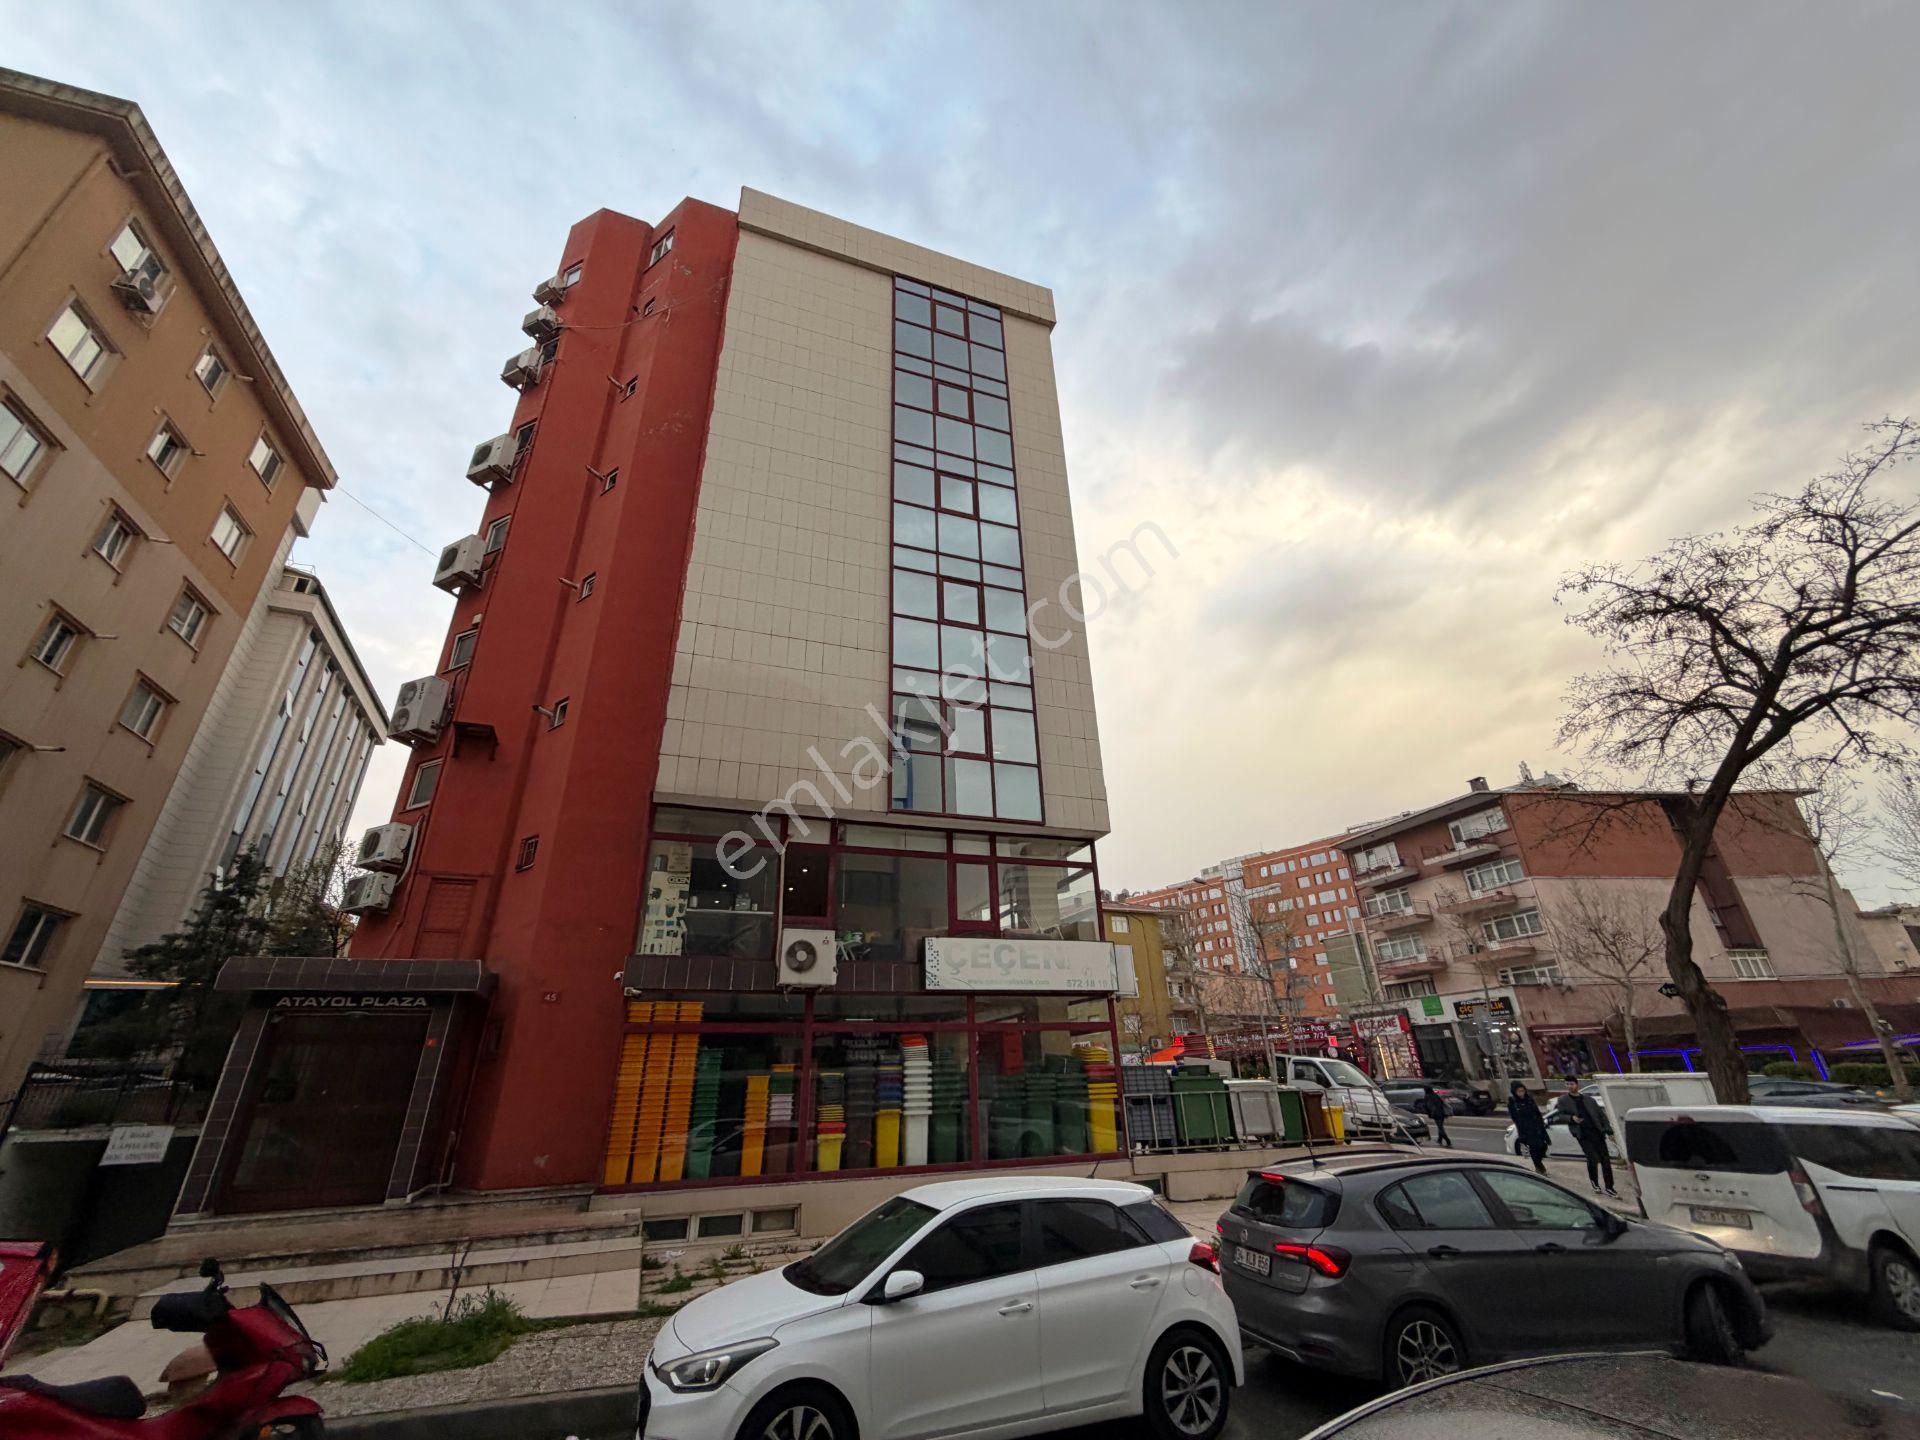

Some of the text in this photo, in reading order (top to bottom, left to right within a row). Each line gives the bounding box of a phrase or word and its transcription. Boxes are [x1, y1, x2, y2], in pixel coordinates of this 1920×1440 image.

[276, 996, 428, 1007] ATAYOL PLAZA
[544, 993, 557, 1002] 45
[1356, 1016, 1398, 1031] ECZANE
